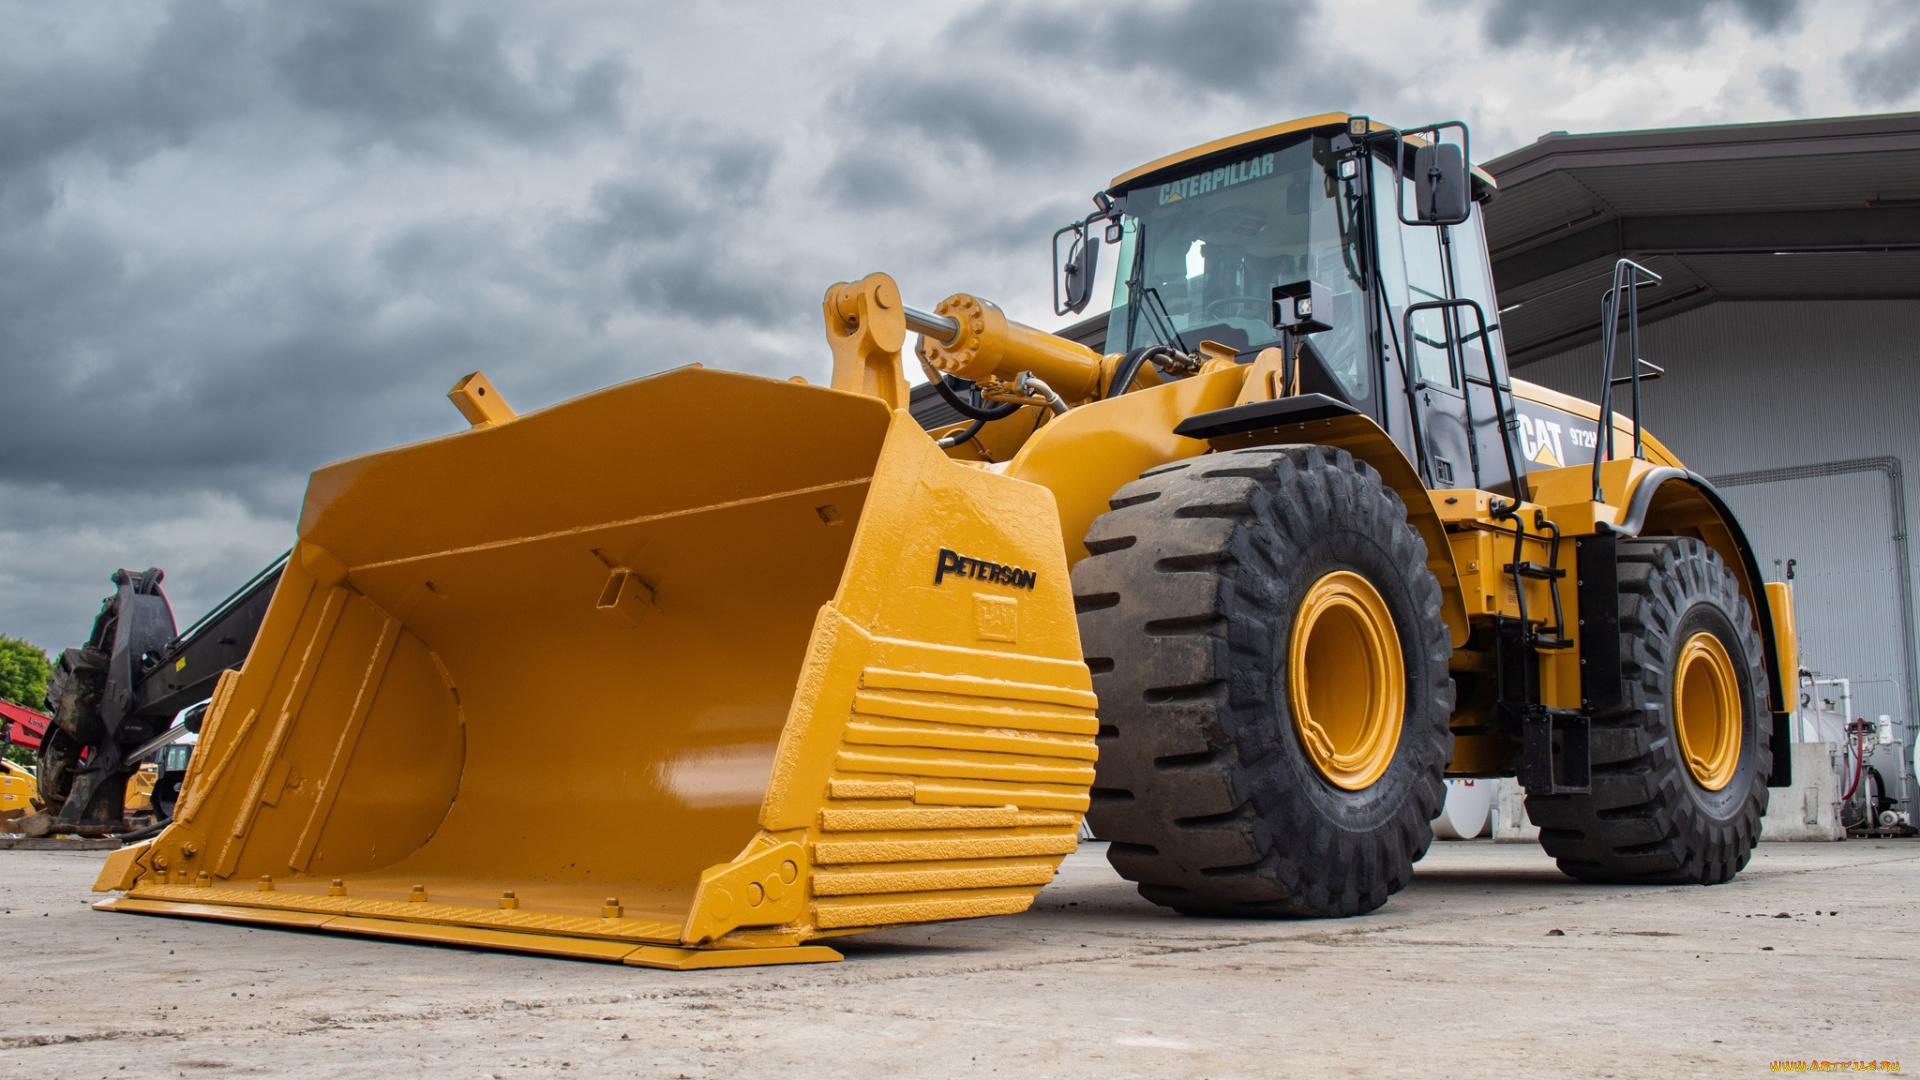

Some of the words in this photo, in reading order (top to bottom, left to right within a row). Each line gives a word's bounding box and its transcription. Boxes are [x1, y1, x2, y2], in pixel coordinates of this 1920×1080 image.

[1159, 153, 1274, 205] CATERPILLAR
[1517, 414, 1565, 468] CAT
[1569, 428, 1598, 448] 972H
[934, 547, 1037, 591] PETERSON
